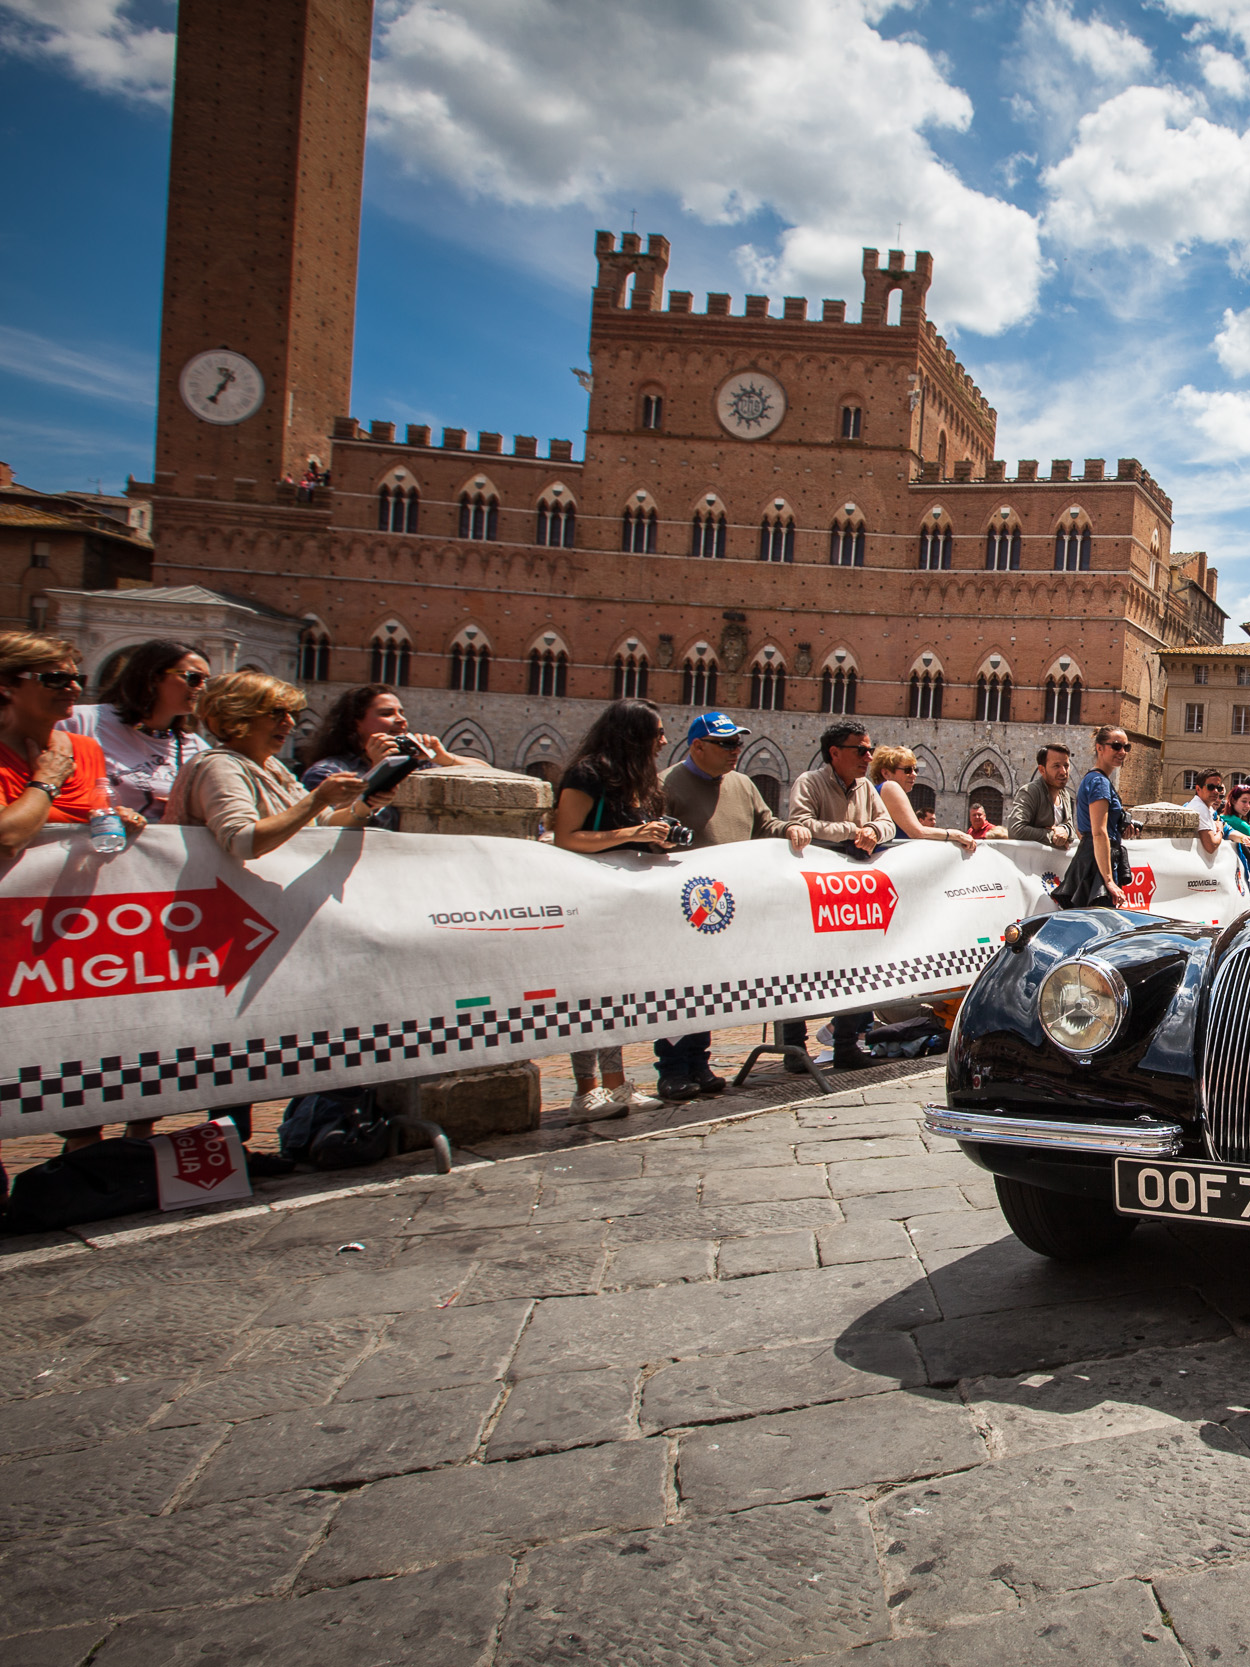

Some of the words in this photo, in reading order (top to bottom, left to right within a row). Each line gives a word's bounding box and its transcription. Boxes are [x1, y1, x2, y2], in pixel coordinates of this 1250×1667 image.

[815, 873, 877, 896] 1000
[21, 900, 203, 943] 1000
[818, 903, 884, 926] MIGLIA
[8, 945, 221, 998] MIGLIA
